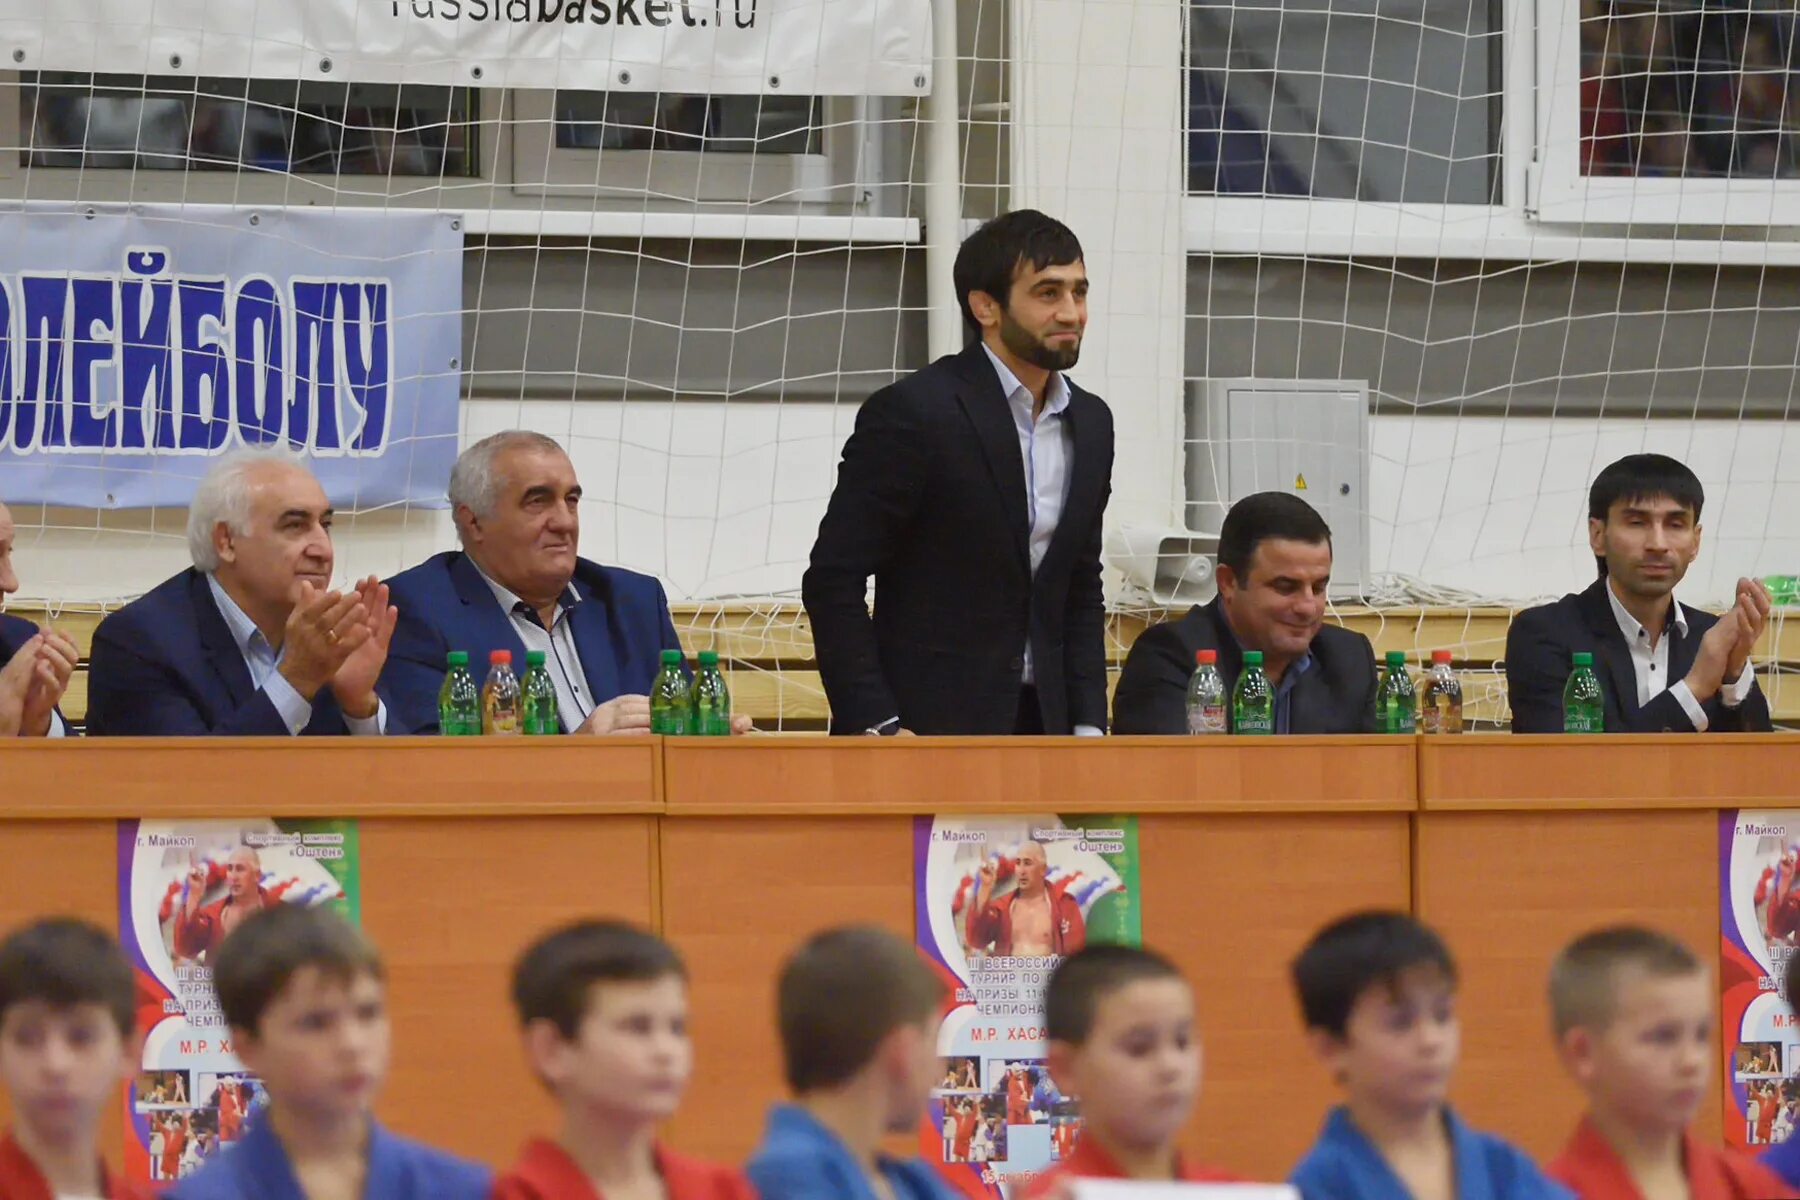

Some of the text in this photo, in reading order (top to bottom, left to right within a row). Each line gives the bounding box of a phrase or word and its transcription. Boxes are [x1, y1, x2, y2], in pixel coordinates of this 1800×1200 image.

[942, 830, 986, 841] Майкоп
[1745, 824, 1786, 836] Майкоп
[148, 835, 195, 847] Майкоп
[970, 973, 1016, 984] ТУРНИР
[1023, 973, 1040, 984] ПО
[179, 983, 217, 994] ТУРН
[976, 988, 1019, 1000] ПРИЗЫ
